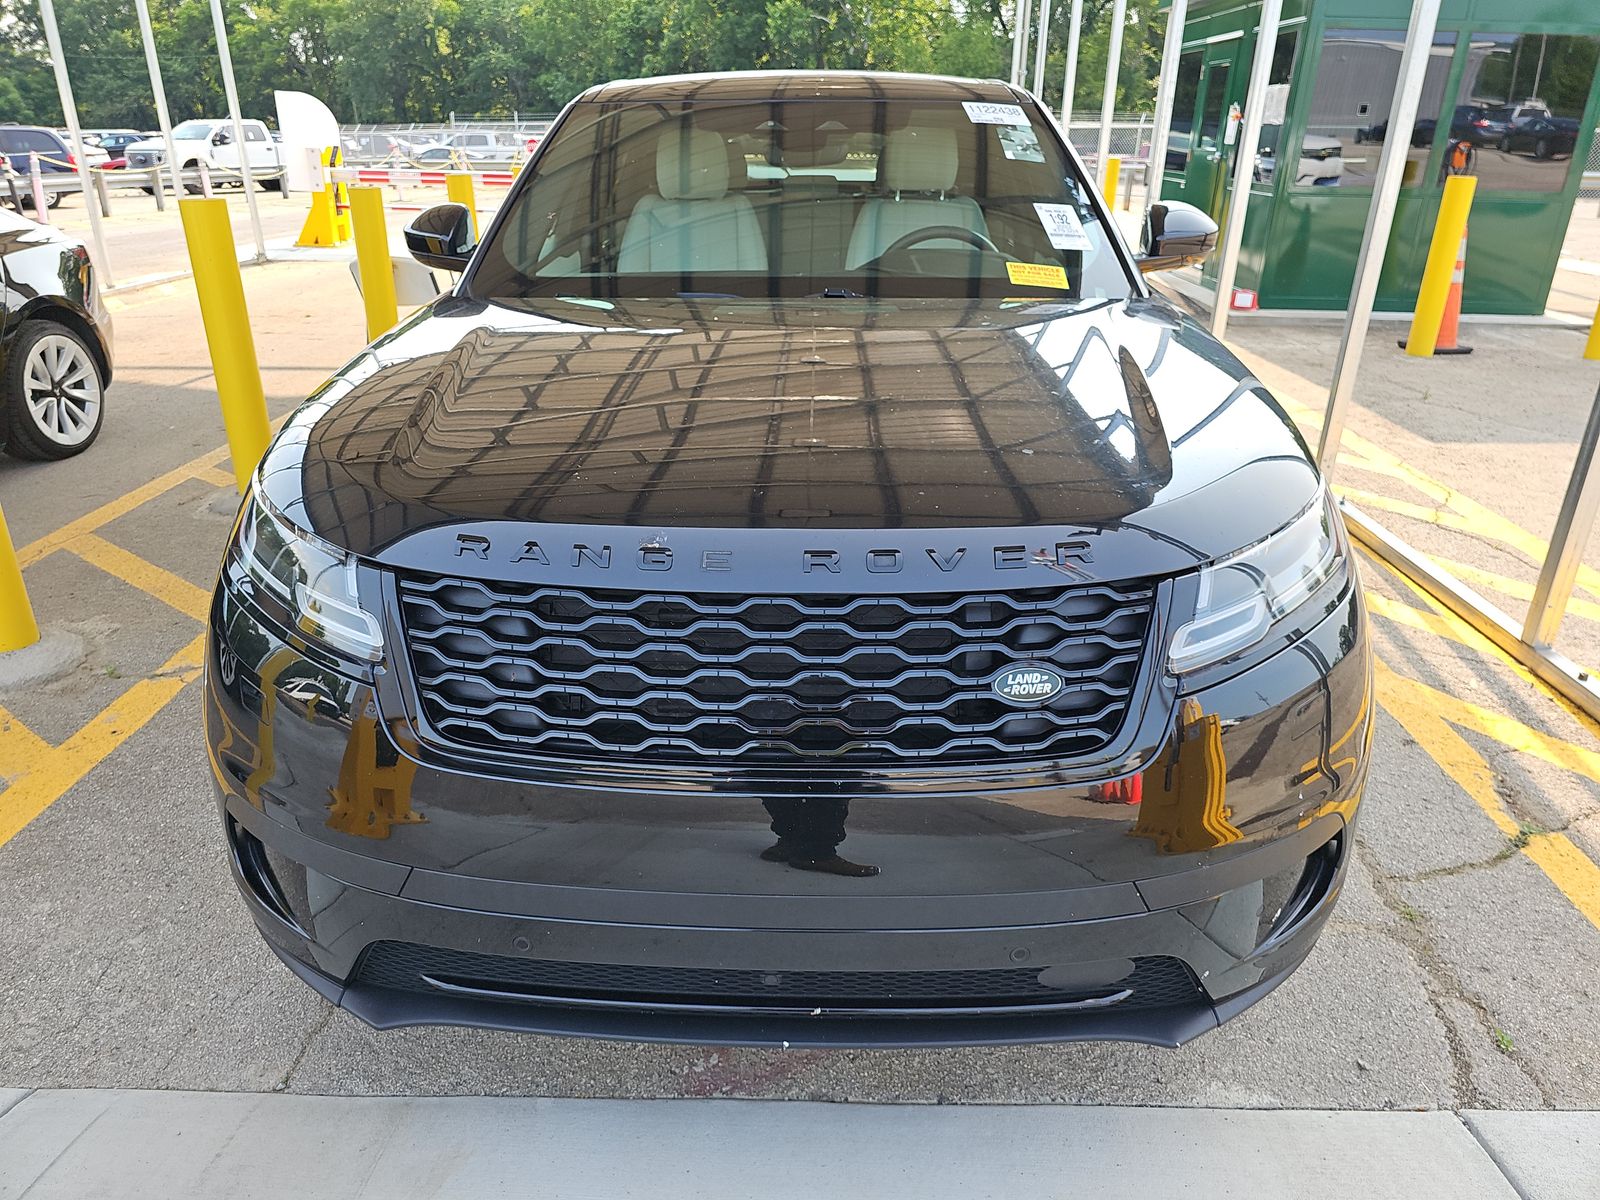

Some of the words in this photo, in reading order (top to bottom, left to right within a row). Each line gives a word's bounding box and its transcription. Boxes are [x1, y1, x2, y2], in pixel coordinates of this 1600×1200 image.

[969, 104, 1020, 116] 1122438
[453, 533, 733, 573] RANGE
[802, 540, 1096, 575] ROVER
[1007, 672, 1041, 685] LAND
[1010, 682, 1053, 695] ROVER
